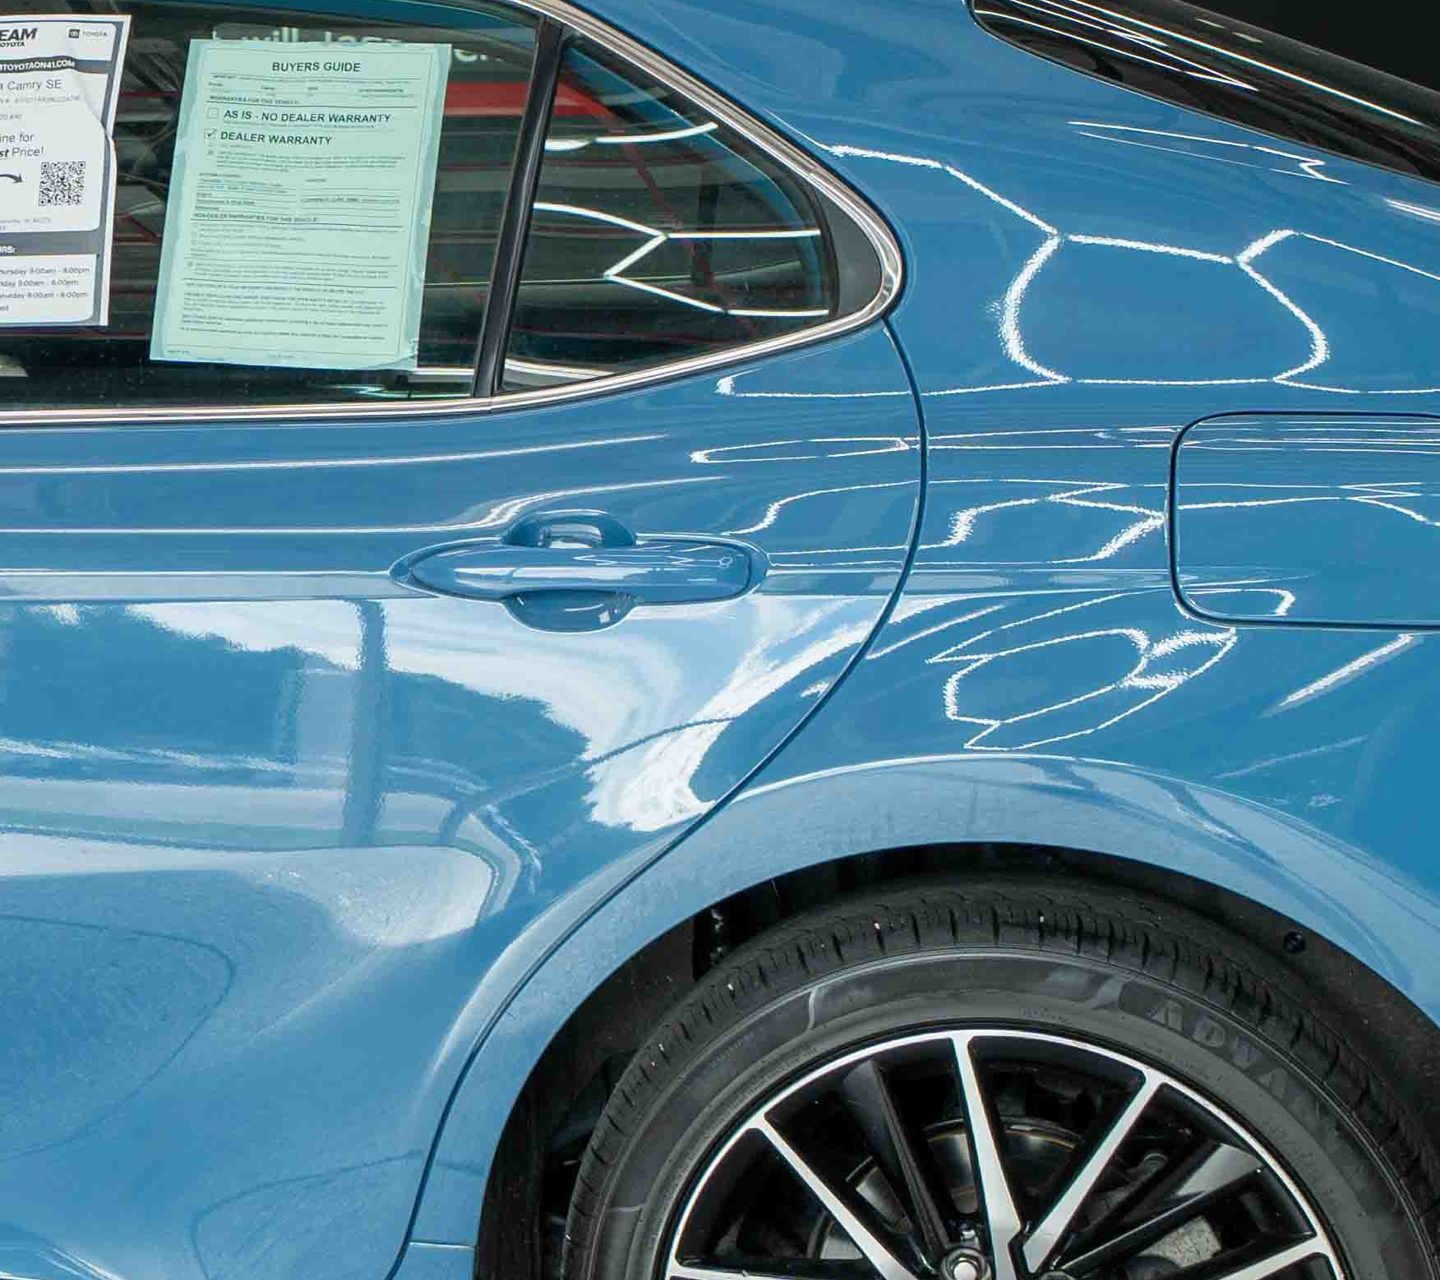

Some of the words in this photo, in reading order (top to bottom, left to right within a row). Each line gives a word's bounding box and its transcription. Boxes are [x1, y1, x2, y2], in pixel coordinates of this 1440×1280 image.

[271, 61, 320, 73] BUYERS
[323, 61, 361, 73] GUIDE
[7, 80, 42, 92] Camry
[46, 79, 62, 89] SE
[223, 109, 239, 119] AS
[241, 110, 253, 120] IS
[261, 112, 279, 121] NO
[281, 113, 326, 122] DEALER
[328, 114, 392, 123] WARRANTY
[18, 132, 35, 143] for
[219, 130, 266, 142] DEALER
[269, 135, 333, 145] WARRANTY
[11, 146, 45, 158] Price!
